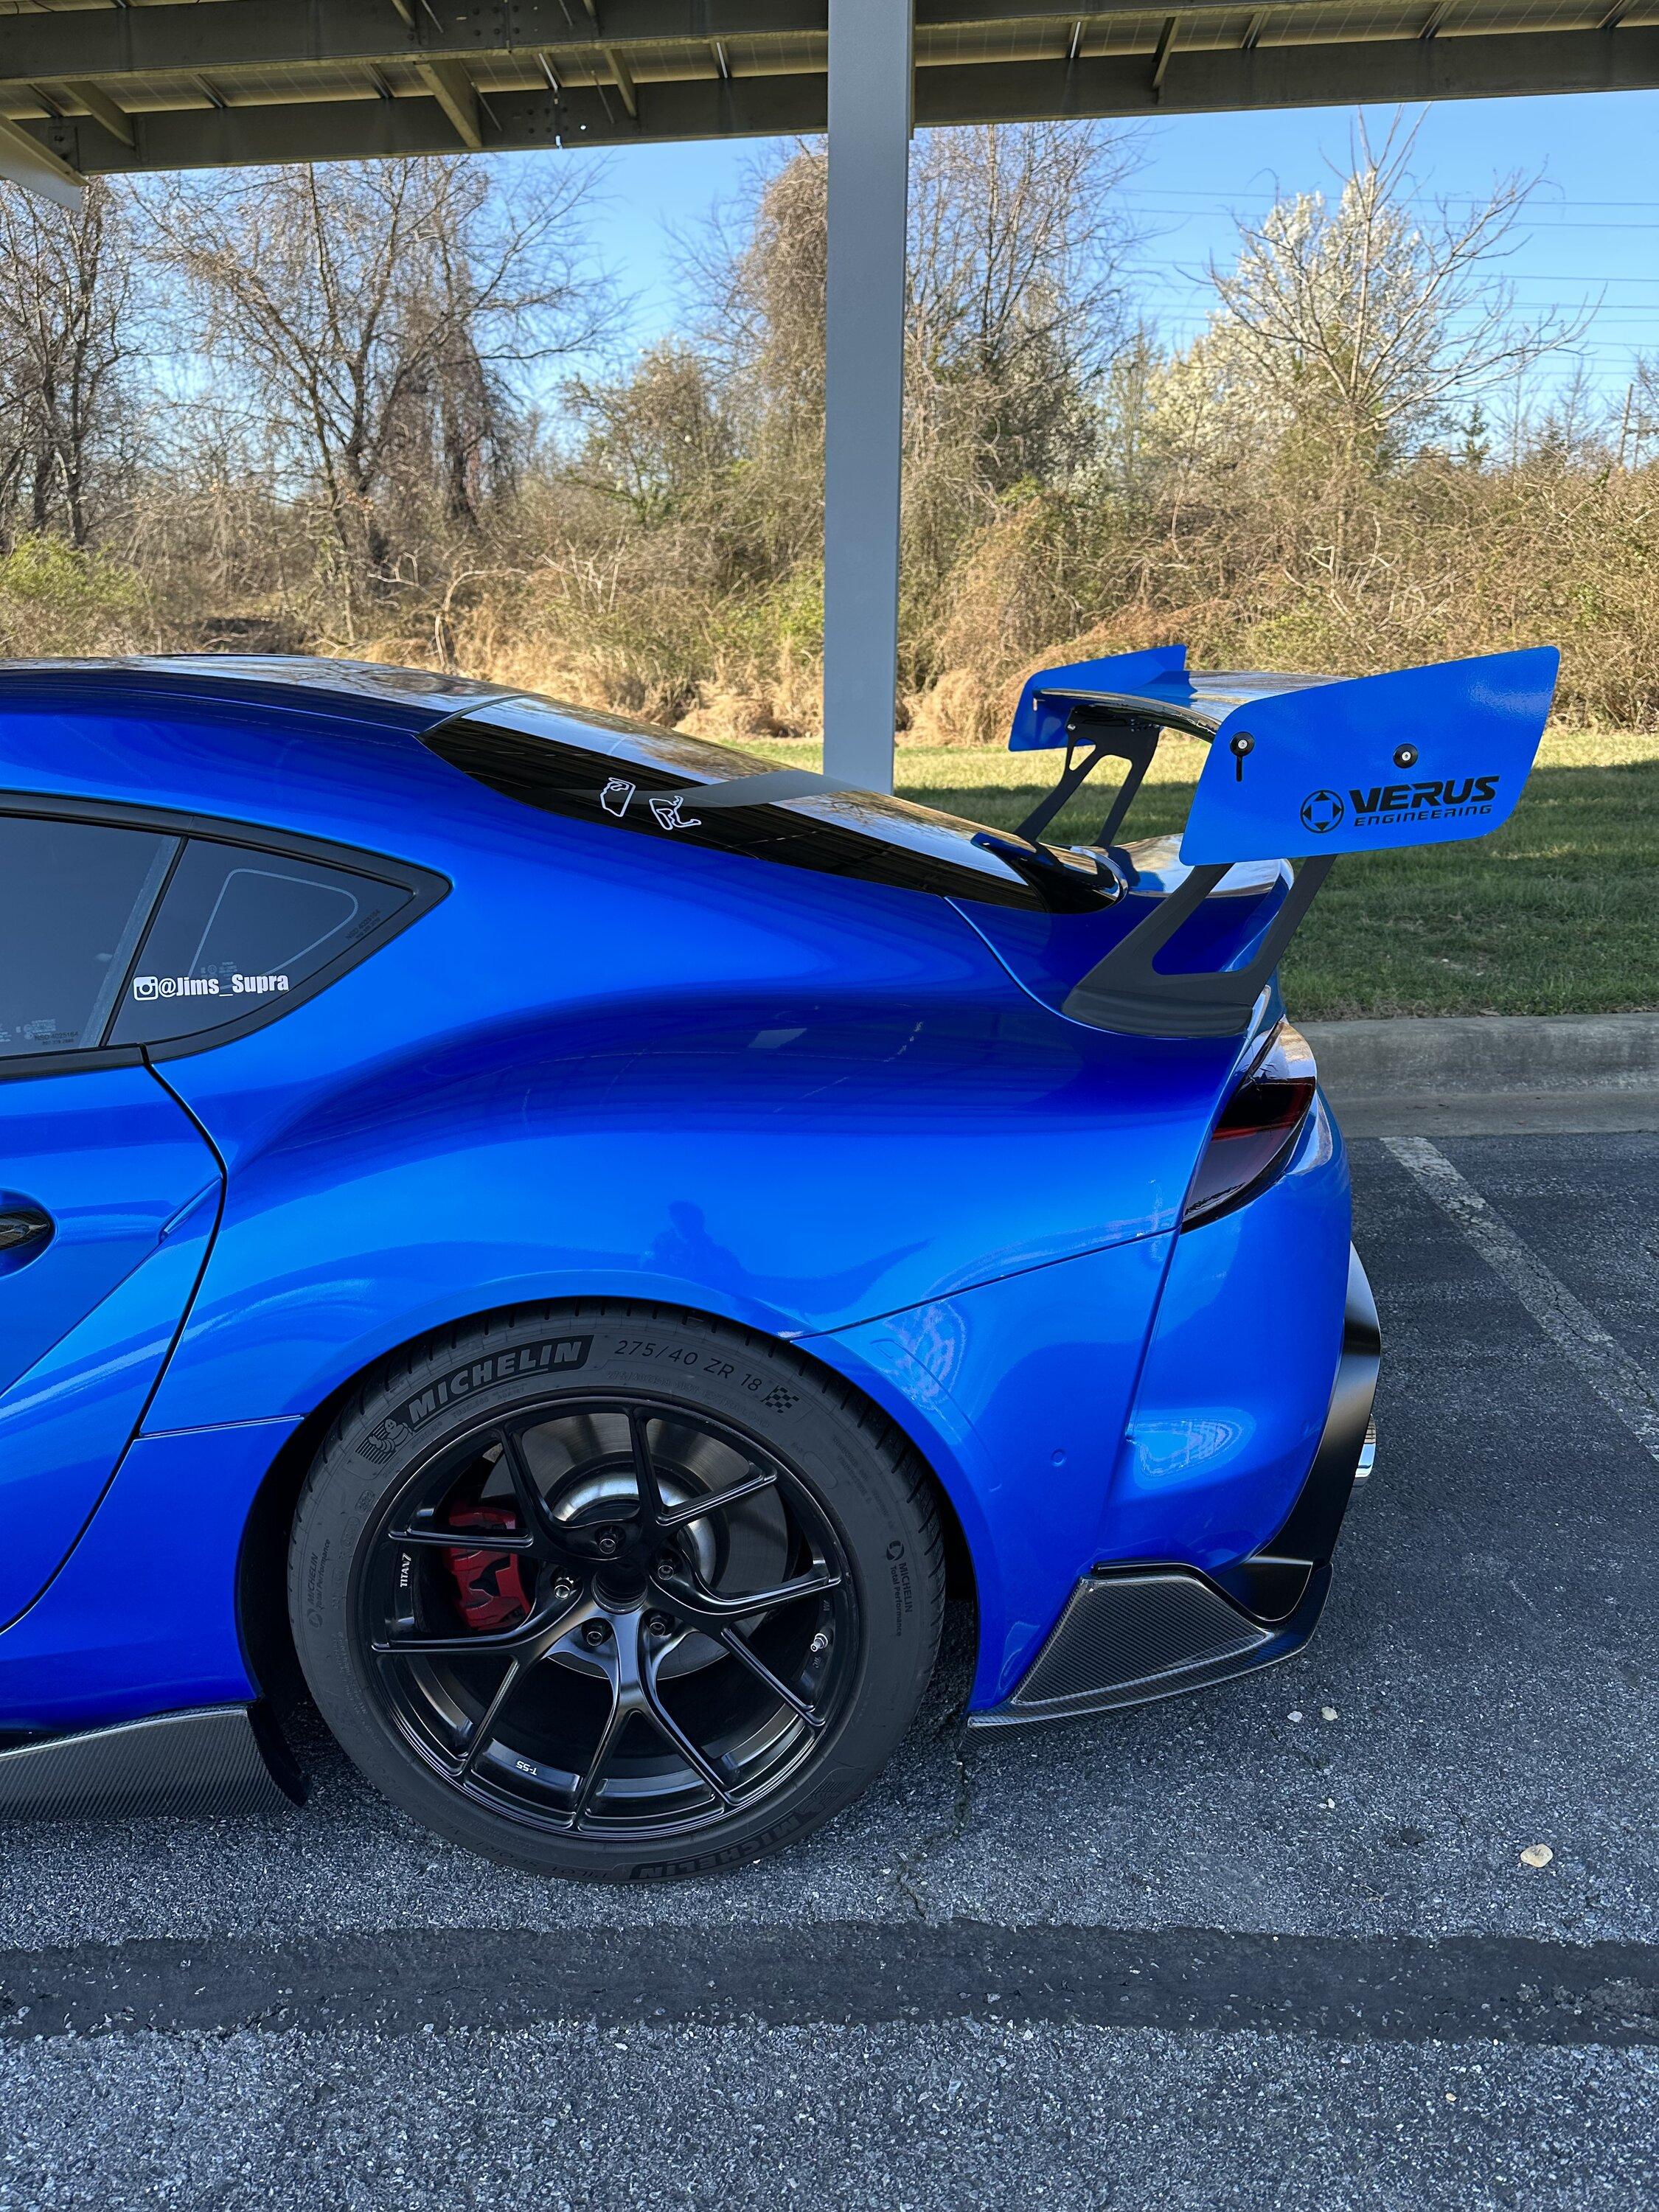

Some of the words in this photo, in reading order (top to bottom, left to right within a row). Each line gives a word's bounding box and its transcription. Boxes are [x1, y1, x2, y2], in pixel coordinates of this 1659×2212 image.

[1349, 775, 1500, 814] VERUS
[1354, 804, 1492, 827] ENGINEERING
[159, 973, 290, 998] @Jims_Supra
[408, 1340, 582, 1424] MICHELIN
[614, 1340, 699, 1366] 275/40
[703, 1357, 735, 1380] ZR
[740, 1373, 763, 1392] 18
[307, 1552, 319, 1605] MICHELIN
[316, 1539, 331, 1588] Performance
[400, 1553, 412, 1587] TITAN7
[890, 1565, 900, 1585] Total
[899, 1562, 913, 1613] MICHELIN
[894, 1587, 903, 1637] Performance
[638, 1815, 801, 1879] MICHELIN
